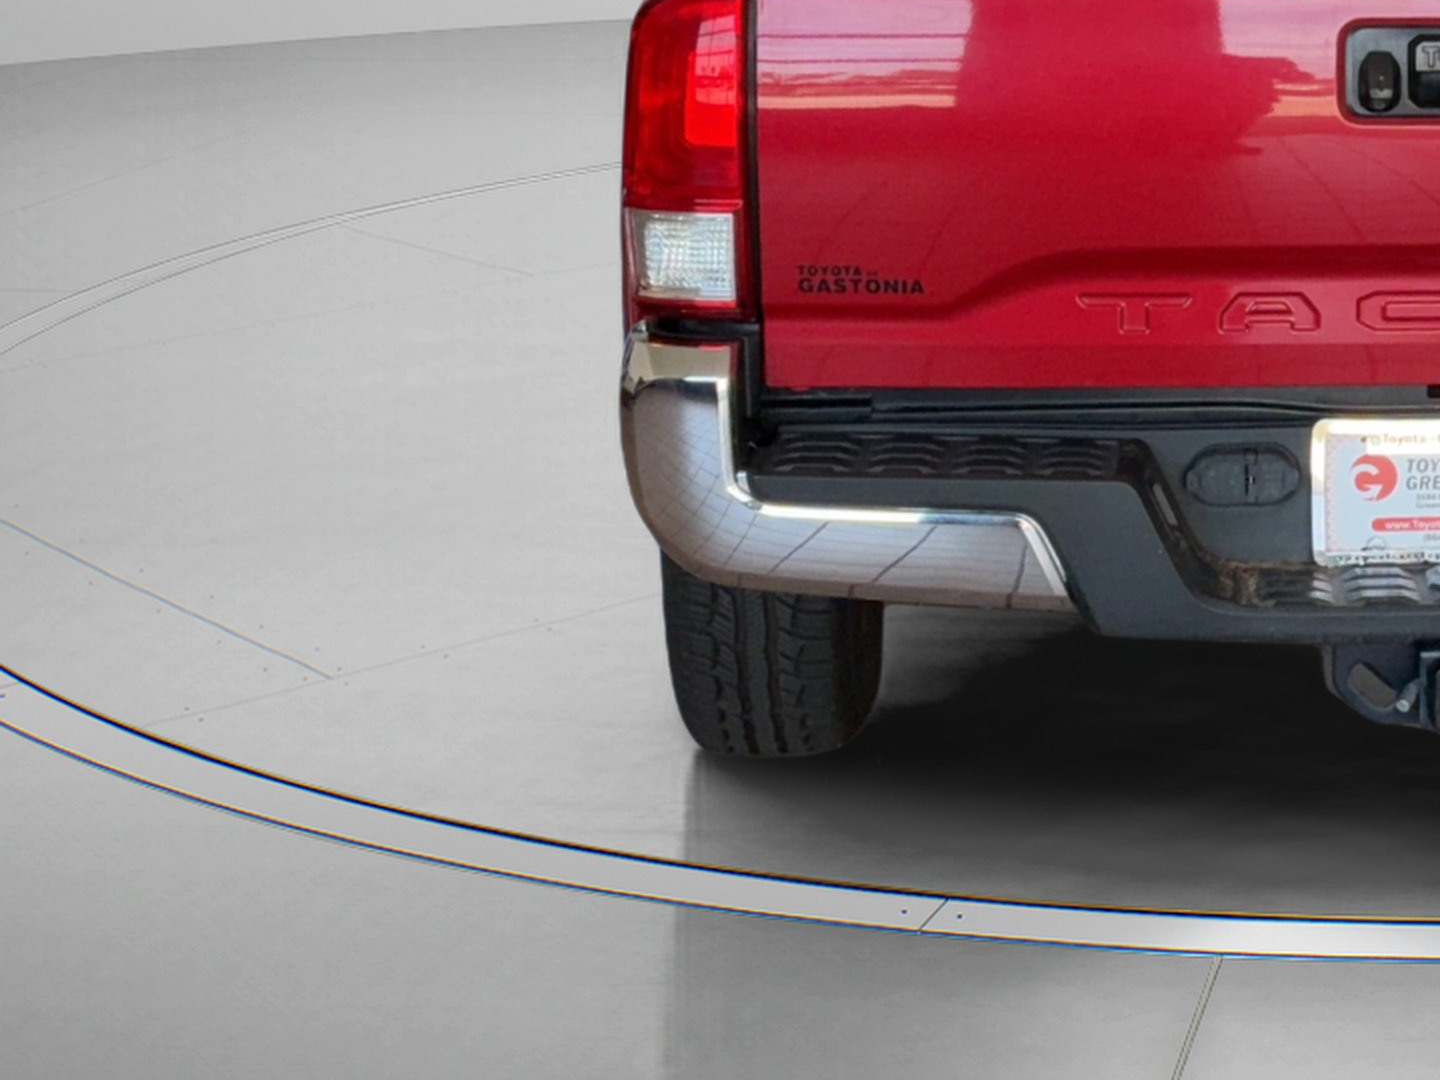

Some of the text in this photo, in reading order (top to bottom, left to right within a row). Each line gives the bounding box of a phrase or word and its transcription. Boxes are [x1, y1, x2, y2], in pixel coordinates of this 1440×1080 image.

[796, 264, 862, 277] TOYOTA
[797, 278, 925, 295] GASTONIA
[1382, 432, 1427, 446] Toyota
